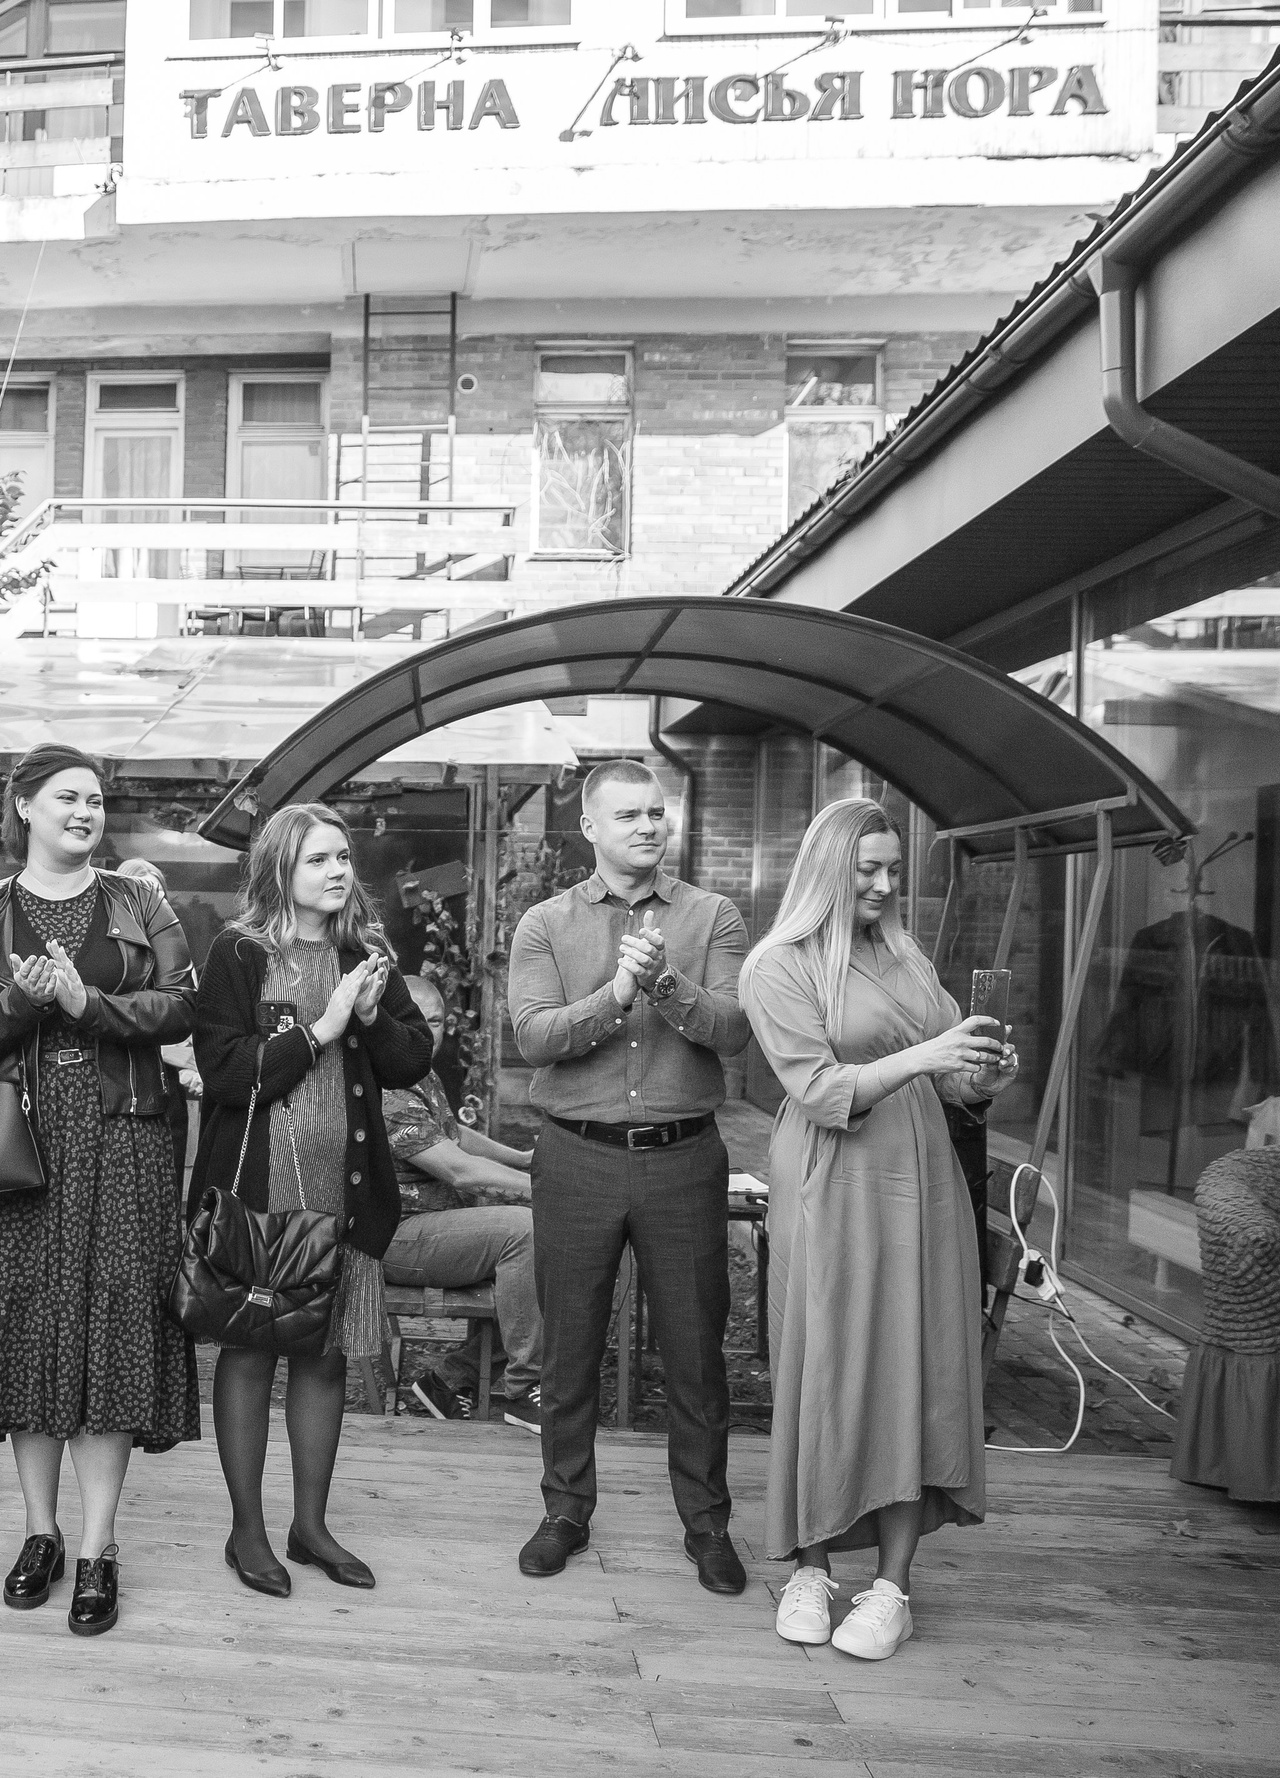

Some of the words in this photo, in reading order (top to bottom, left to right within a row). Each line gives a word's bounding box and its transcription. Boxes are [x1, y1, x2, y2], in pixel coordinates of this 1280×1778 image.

[179, 79, 521, 139] ТАВЕРНА
[599, 70, 865, 127] ЛИСЬЯ
[890, 63, 1110, 119] НОРА
